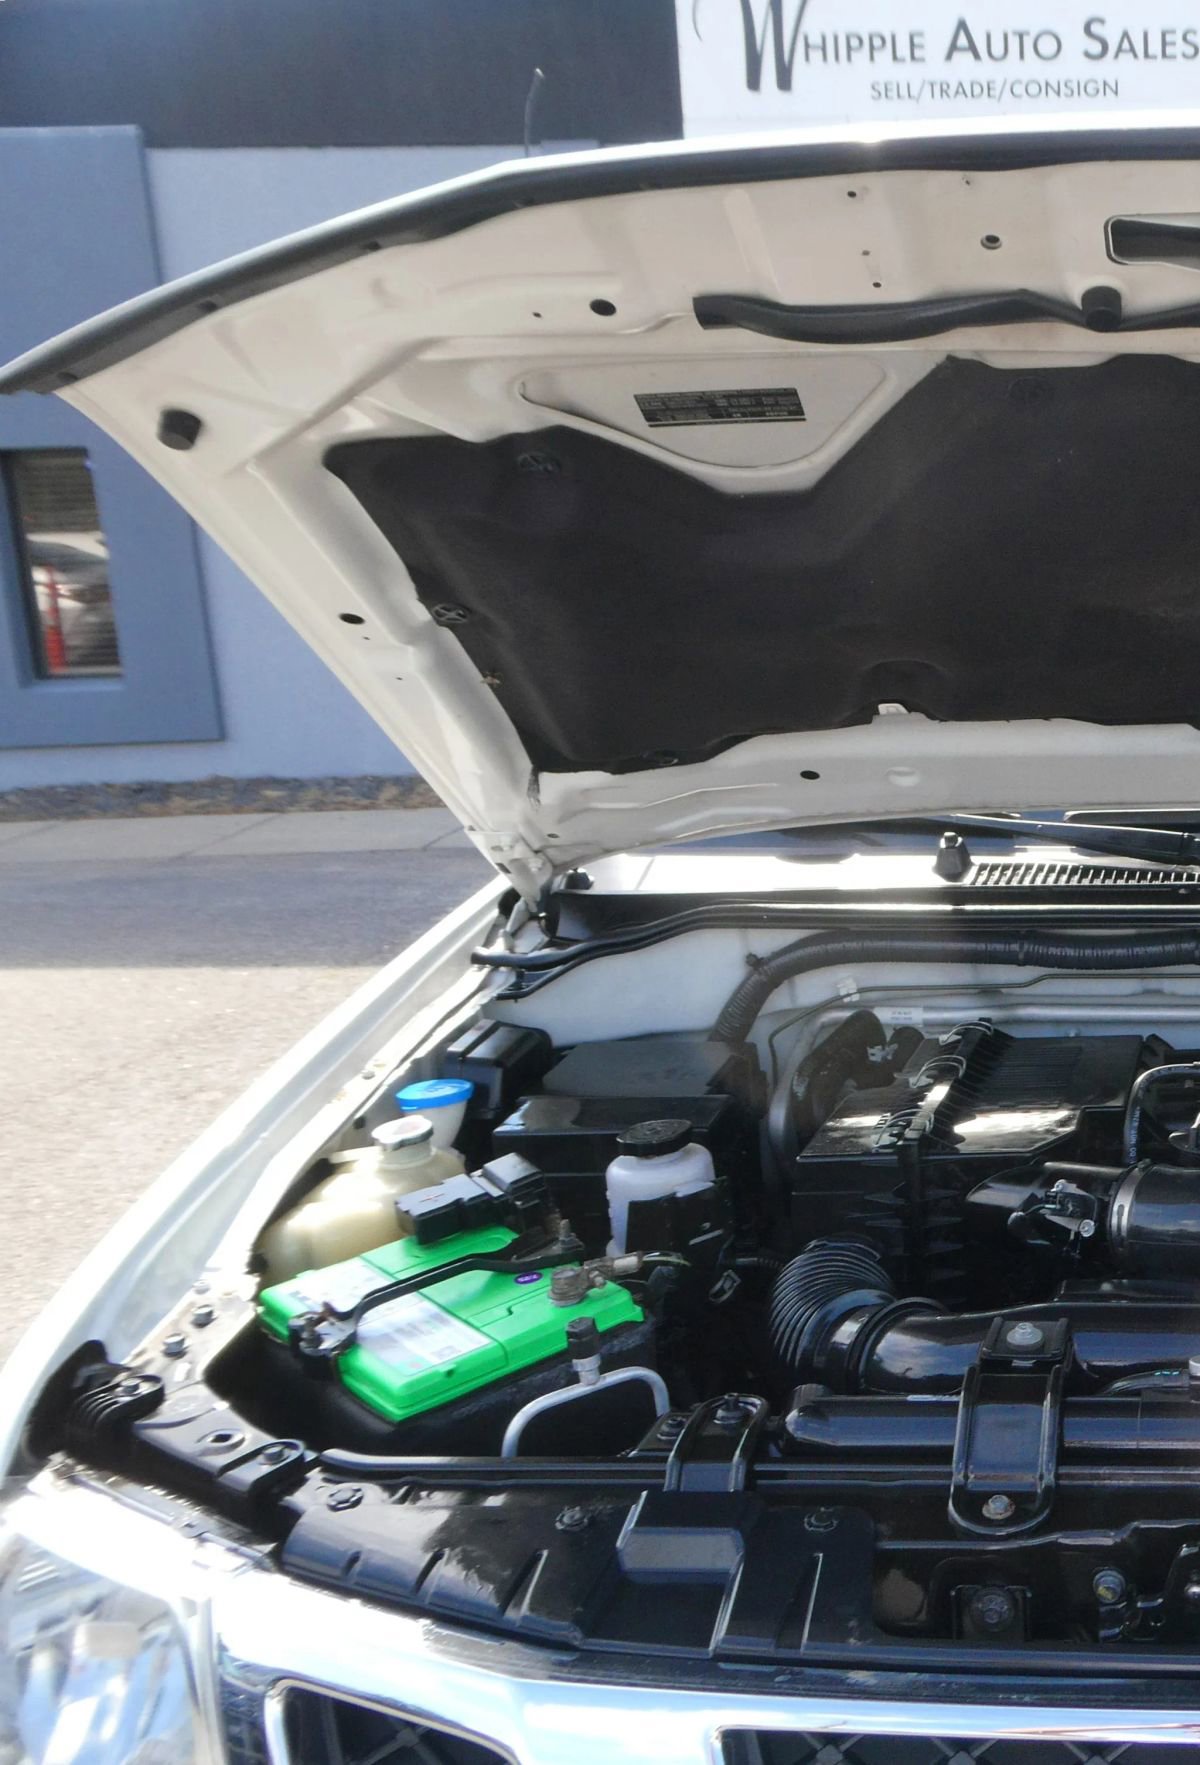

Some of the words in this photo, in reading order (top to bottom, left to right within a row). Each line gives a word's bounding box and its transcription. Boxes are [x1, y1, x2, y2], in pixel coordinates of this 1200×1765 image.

[738, 0, 926, 92] WHIPPLE
[944, 17, 1063, 63] AUTO
[1082, 17, 1200, 61] SALES
[870, 78, 1120, 101] SELL/TRADE/CONSIGN
